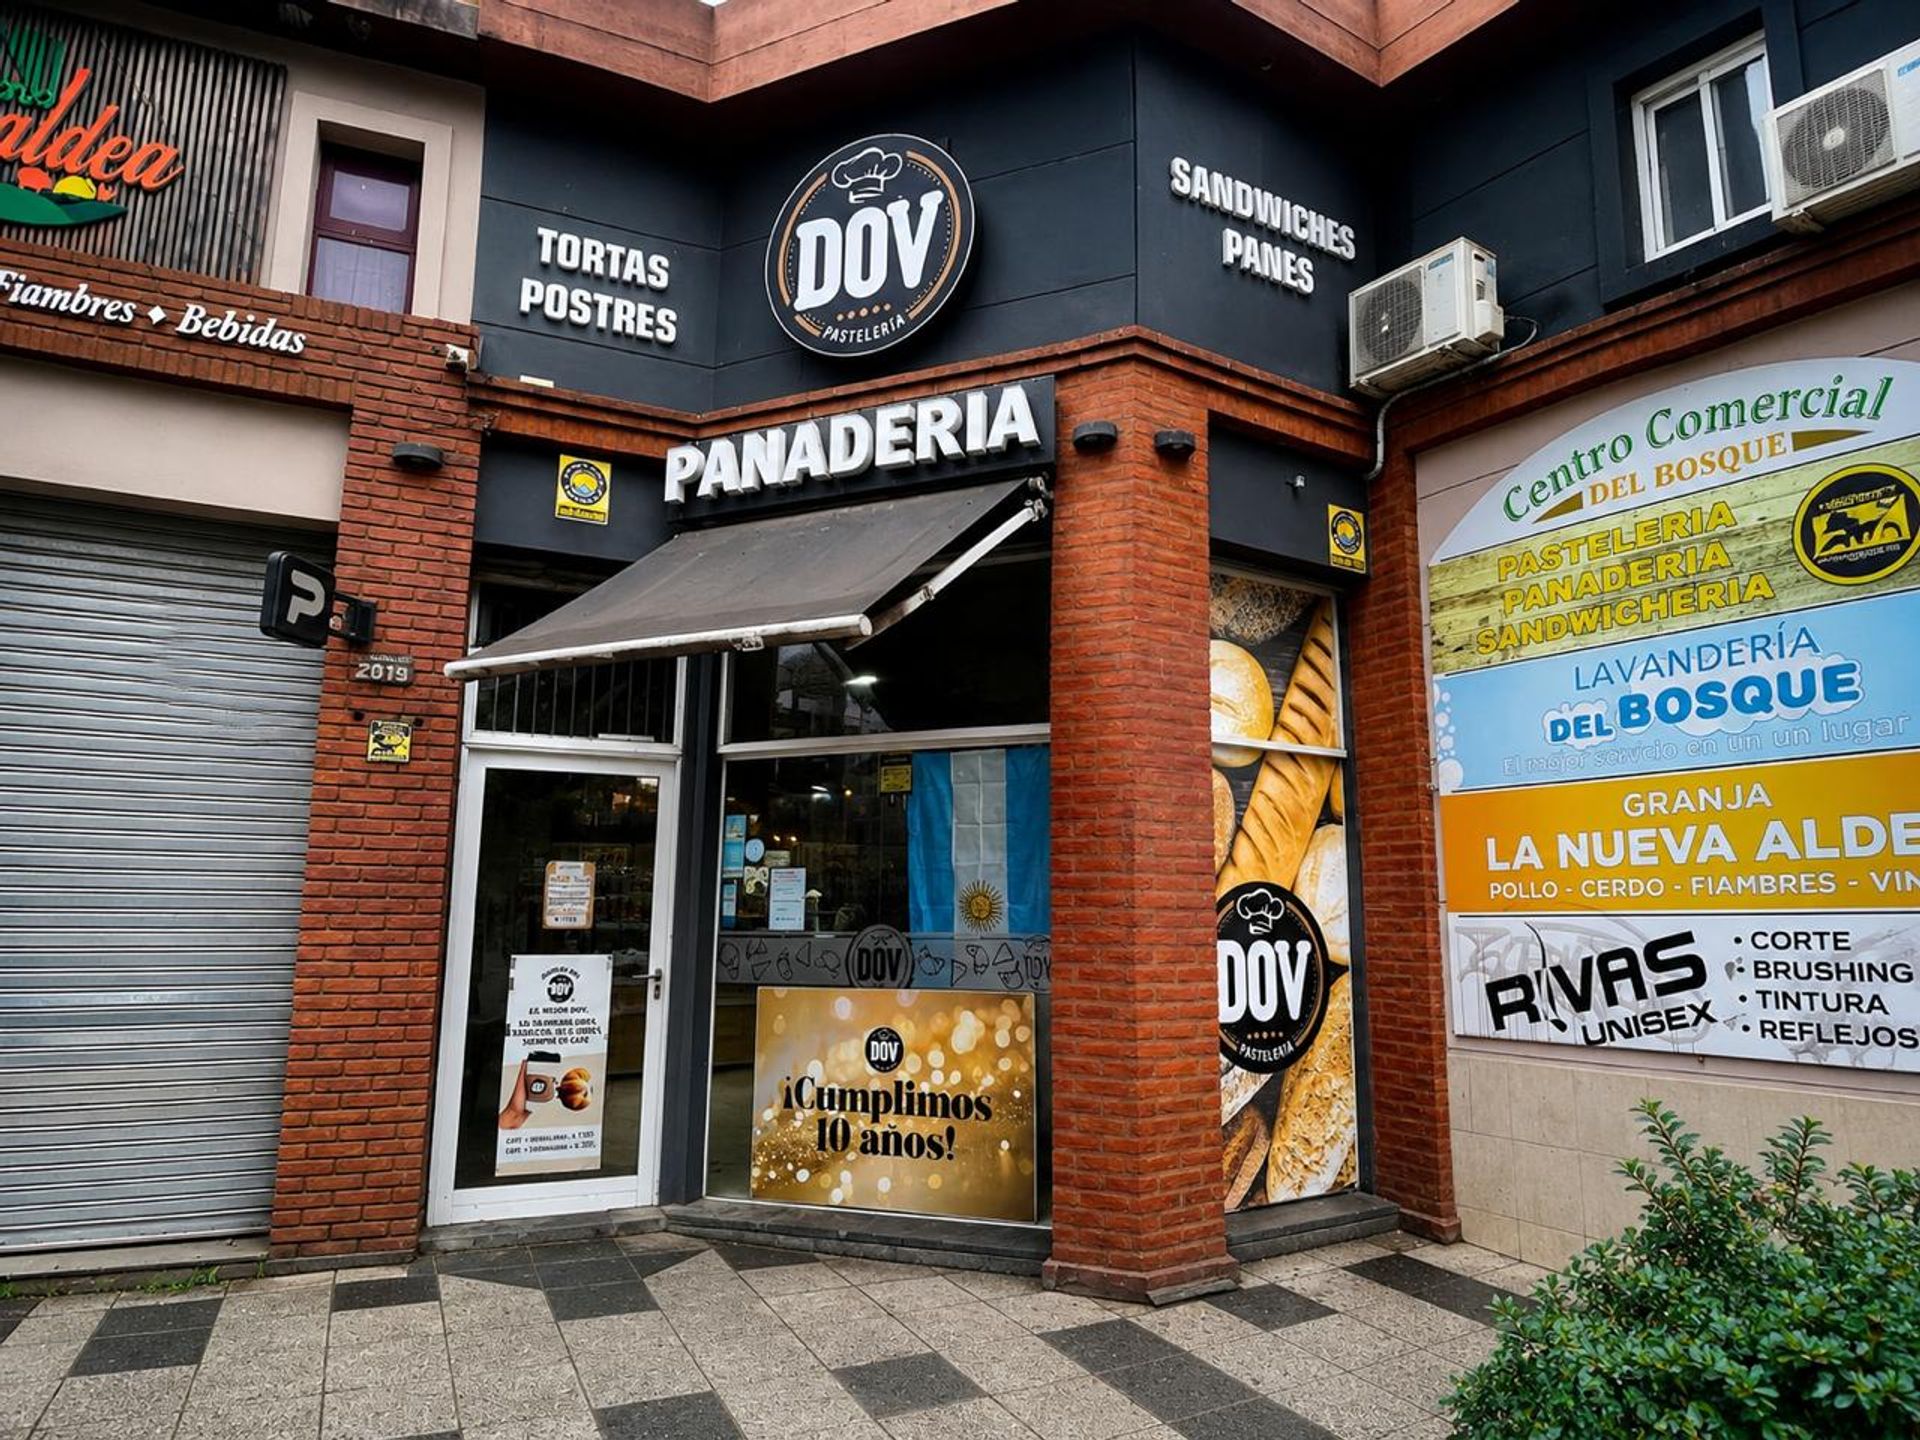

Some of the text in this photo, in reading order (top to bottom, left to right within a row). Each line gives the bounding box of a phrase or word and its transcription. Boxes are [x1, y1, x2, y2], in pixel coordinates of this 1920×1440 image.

[1169, 156, 1357, 262] SANDWICHES
[536, 226, 671, 291] TORTAS
[793, 190, 945, 311] DOV
[1221, 227, 1315, 295] PANES
[175, 302, 307, 354] Bebidas
[519, 277, 678, 345] POSTRES
[664, 384, 1042, 503] PANADERIA
[1501, 373, 1894, 523] Centro Comercial
[1588, 431, 1787, 506] DEL BOSQUE
[1498, 500, 1738, 582] PASTELERIA
[1502, 539, 1735, 616] PANADERIA
[1475, 571, 1775, 656] SANDWICHERIA
[355, 662, 409, 682] 2019
[1574, 622, 1821, 691] LAVANDERÍA
[1549, 661, 1862, 743] DEL BOSQUE
[1686, 736, 1718, 757] en
[1727, 733, 1761, 754] un
[1773, 726, 1810, 748] un
[1821, 713, 1911, 746] lugar
[1622, 782, 1773, 819] GRANJA
[1485, 812, 1920, 873] LA NUEVA ALDE
[1489, 880, 1559, 900] POLLO
[1581, 878, 1665, 899] CERDO
[1691, 871, 1838, 897] FIAMBRES
[1750, 931, 1852, 951] CORTE
[1753, 960, 1915, 984] BRUSHING
[1217, 939, 1312, 1023] DOV
[1485, 928, 1708, 1034] RIVAS
[1755, 989, 1891, 1015] TINTURA
[870, 1040, 900, 1062] DOV
[1581, 999, 1719, 1046] UNISEX
[1759, 1019, 1920, 1049] REFLEJOS
[816, 1117, 956, 1161] 10 años!
